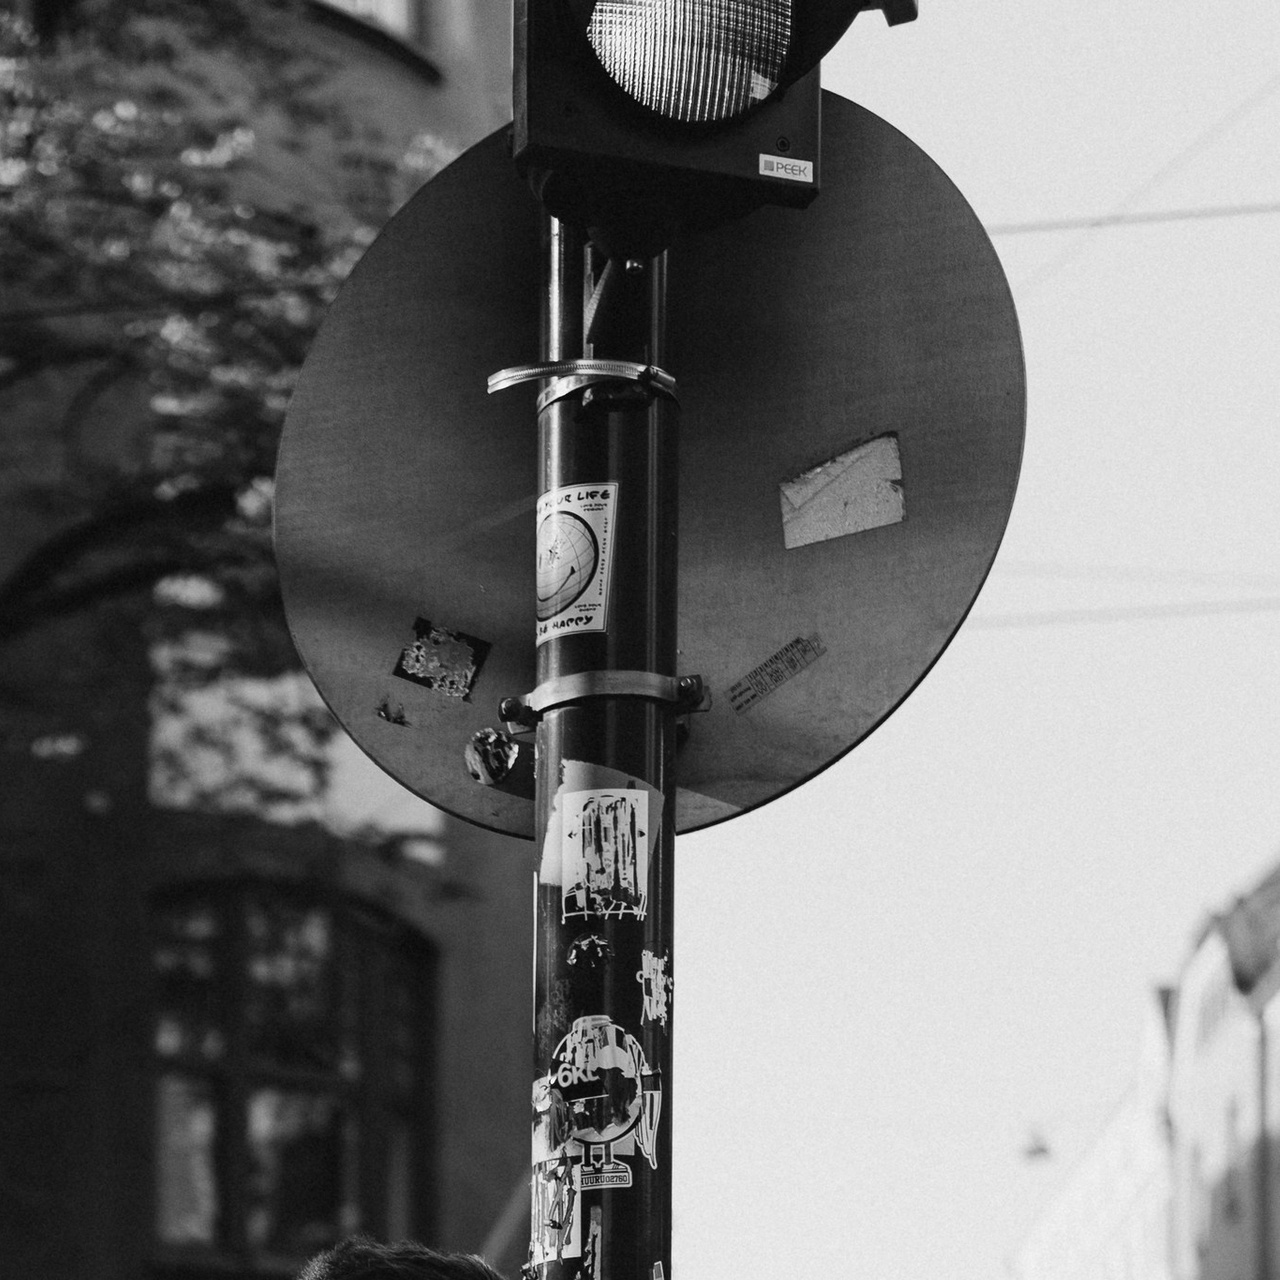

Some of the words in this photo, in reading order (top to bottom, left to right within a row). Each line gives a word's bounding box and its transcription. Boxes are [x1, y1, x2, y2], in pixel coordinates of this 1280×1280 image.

[776, 161, 808, 177] PEEK
[577, 489, 611, 501] LIFE
[552, 615, 594, 630] HAPPY
